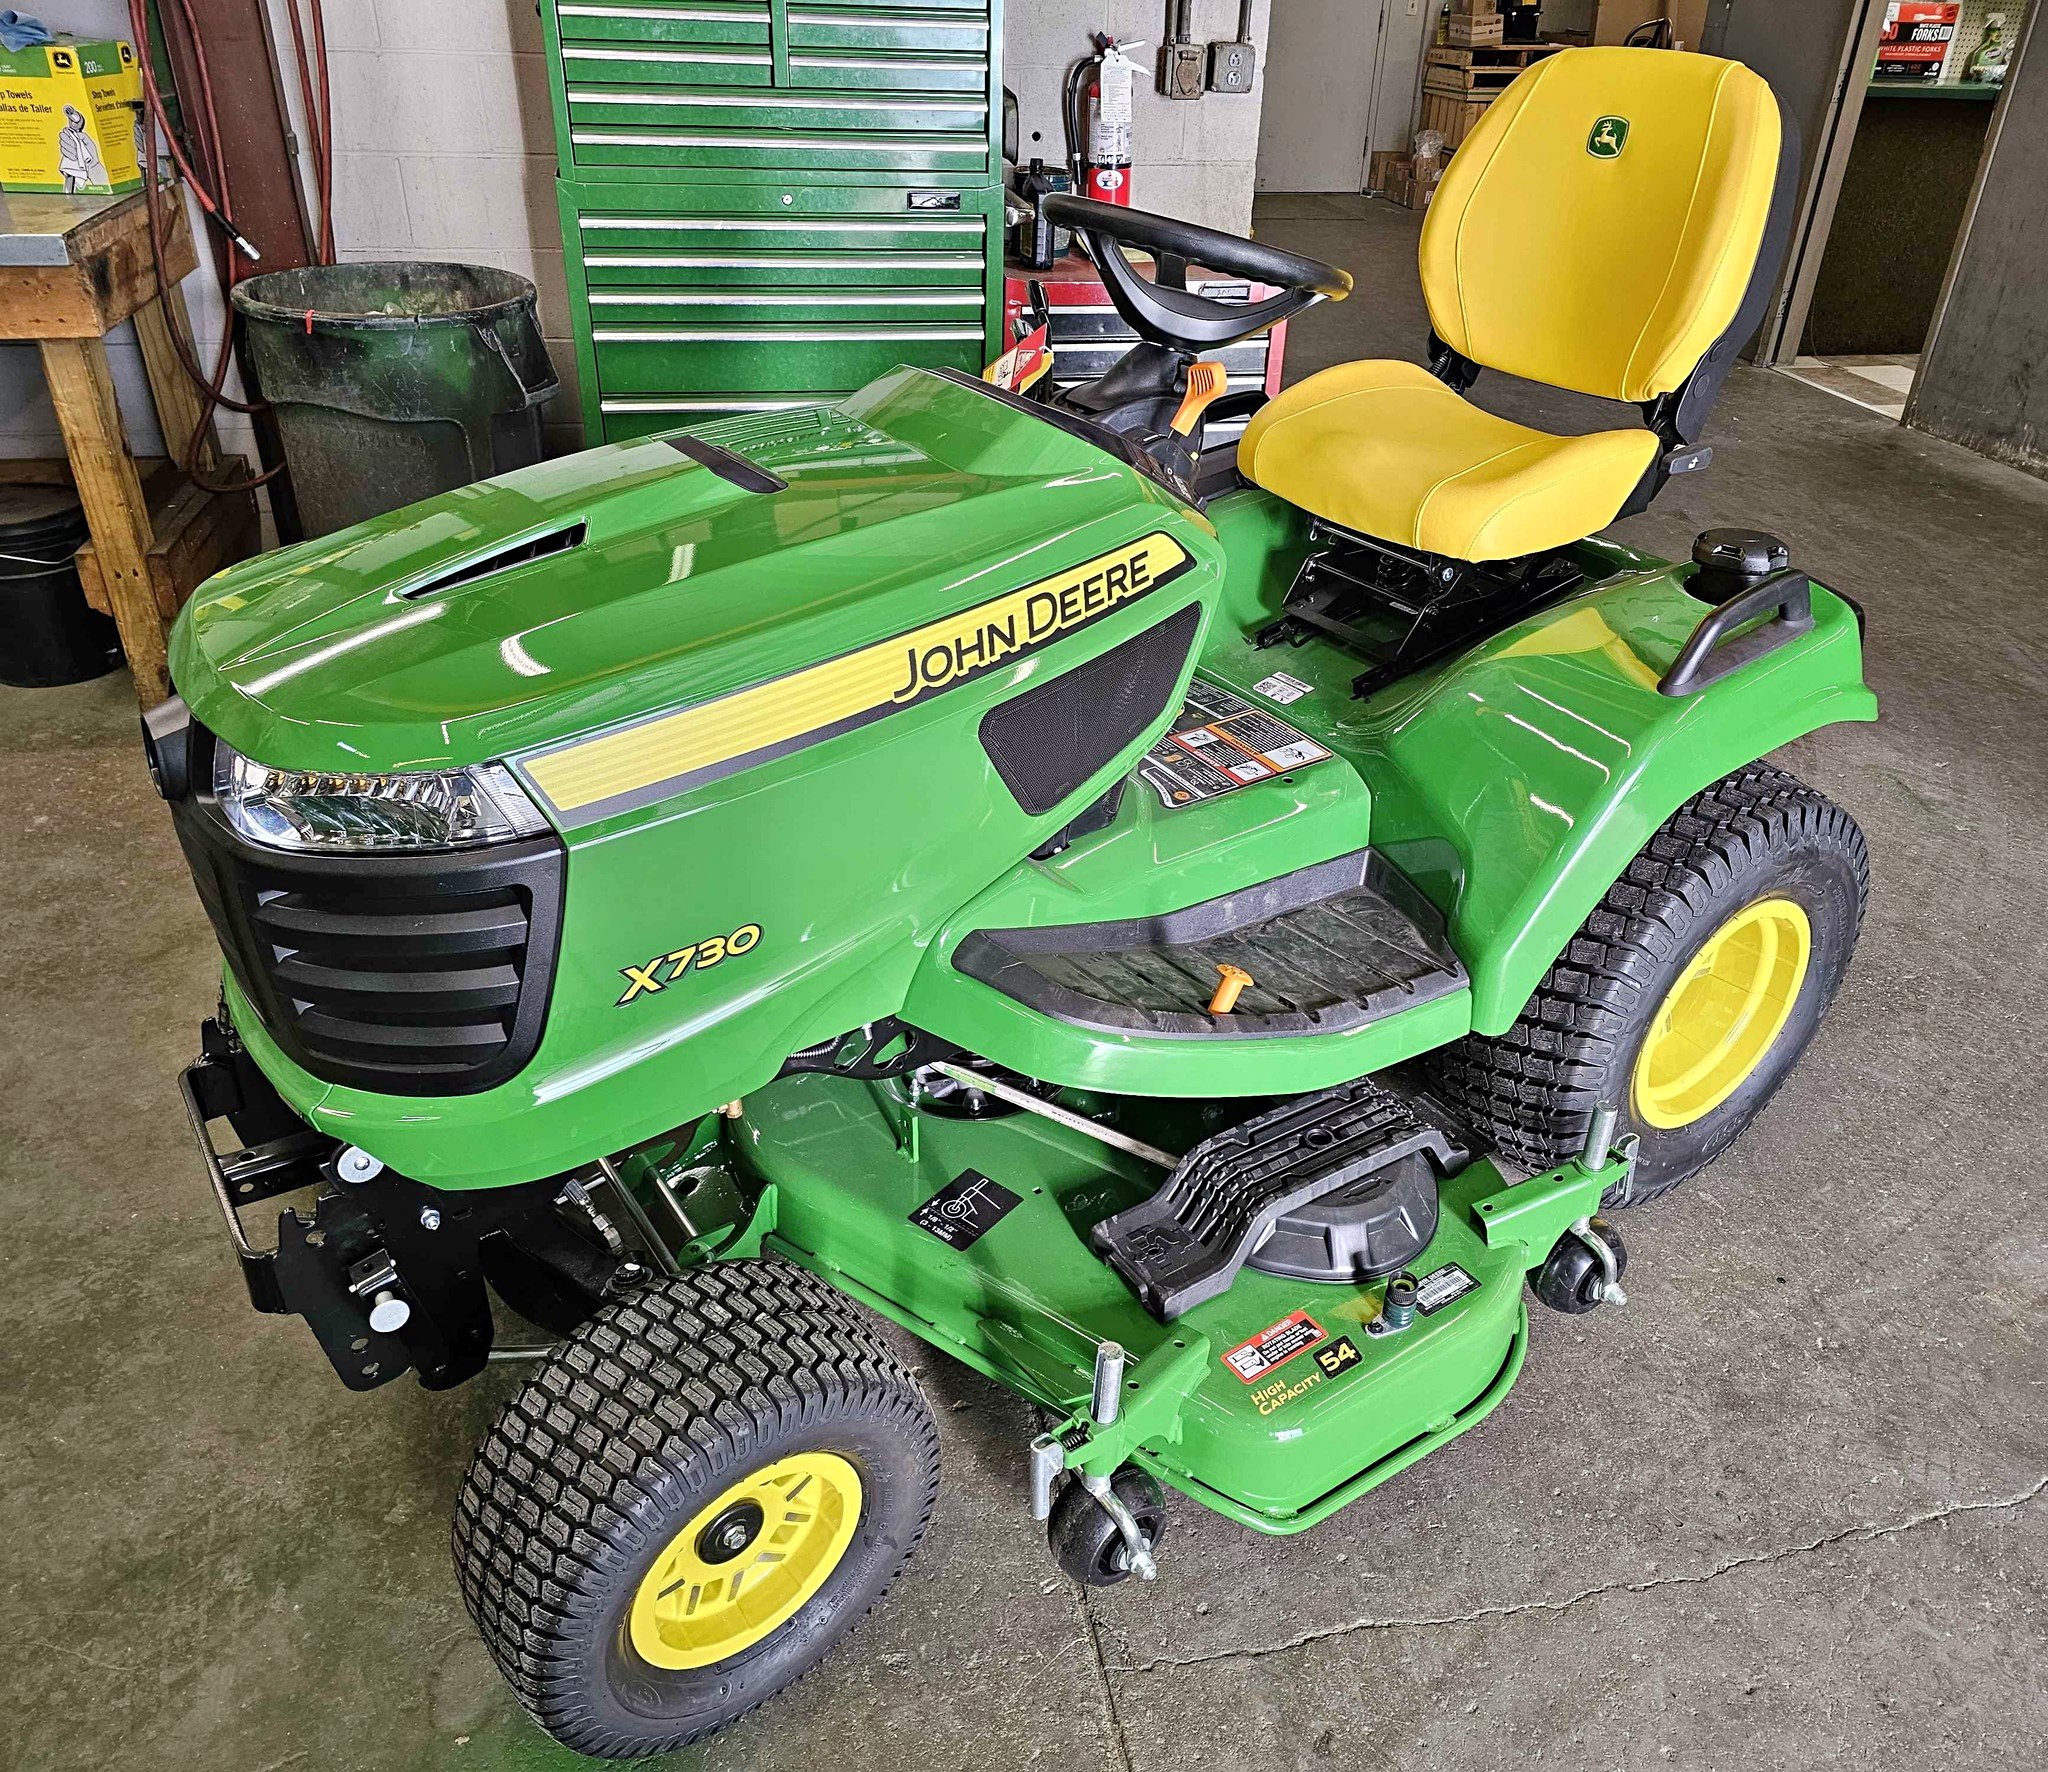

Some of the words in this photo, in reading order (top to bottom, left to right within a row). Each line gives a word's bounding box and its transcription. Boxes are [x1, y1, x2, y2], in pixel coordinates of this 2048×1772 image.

[1911, 28, 1939, 41] FORKS
[84, 60, 97, 74] 200
[6, 90, 33, 100] Towels
[19, 104, 29, 113] de
[30, 104, 53, 114] Taller
[893, 614, 1016, 699] JOHN
[1026, 550, 1150, 640] DEERE
[613, 923, 764, 1007] X730
[1266, 1319, 1293, 1337] DANGER
[1261, 1333, 1287, 1351] ROTATING
[1319, 1343, 1356, 1372] 54
[1250, 1379, 1286, 1406] HIGH
[1259, 1371, 1322, 1416] CAPACITY
